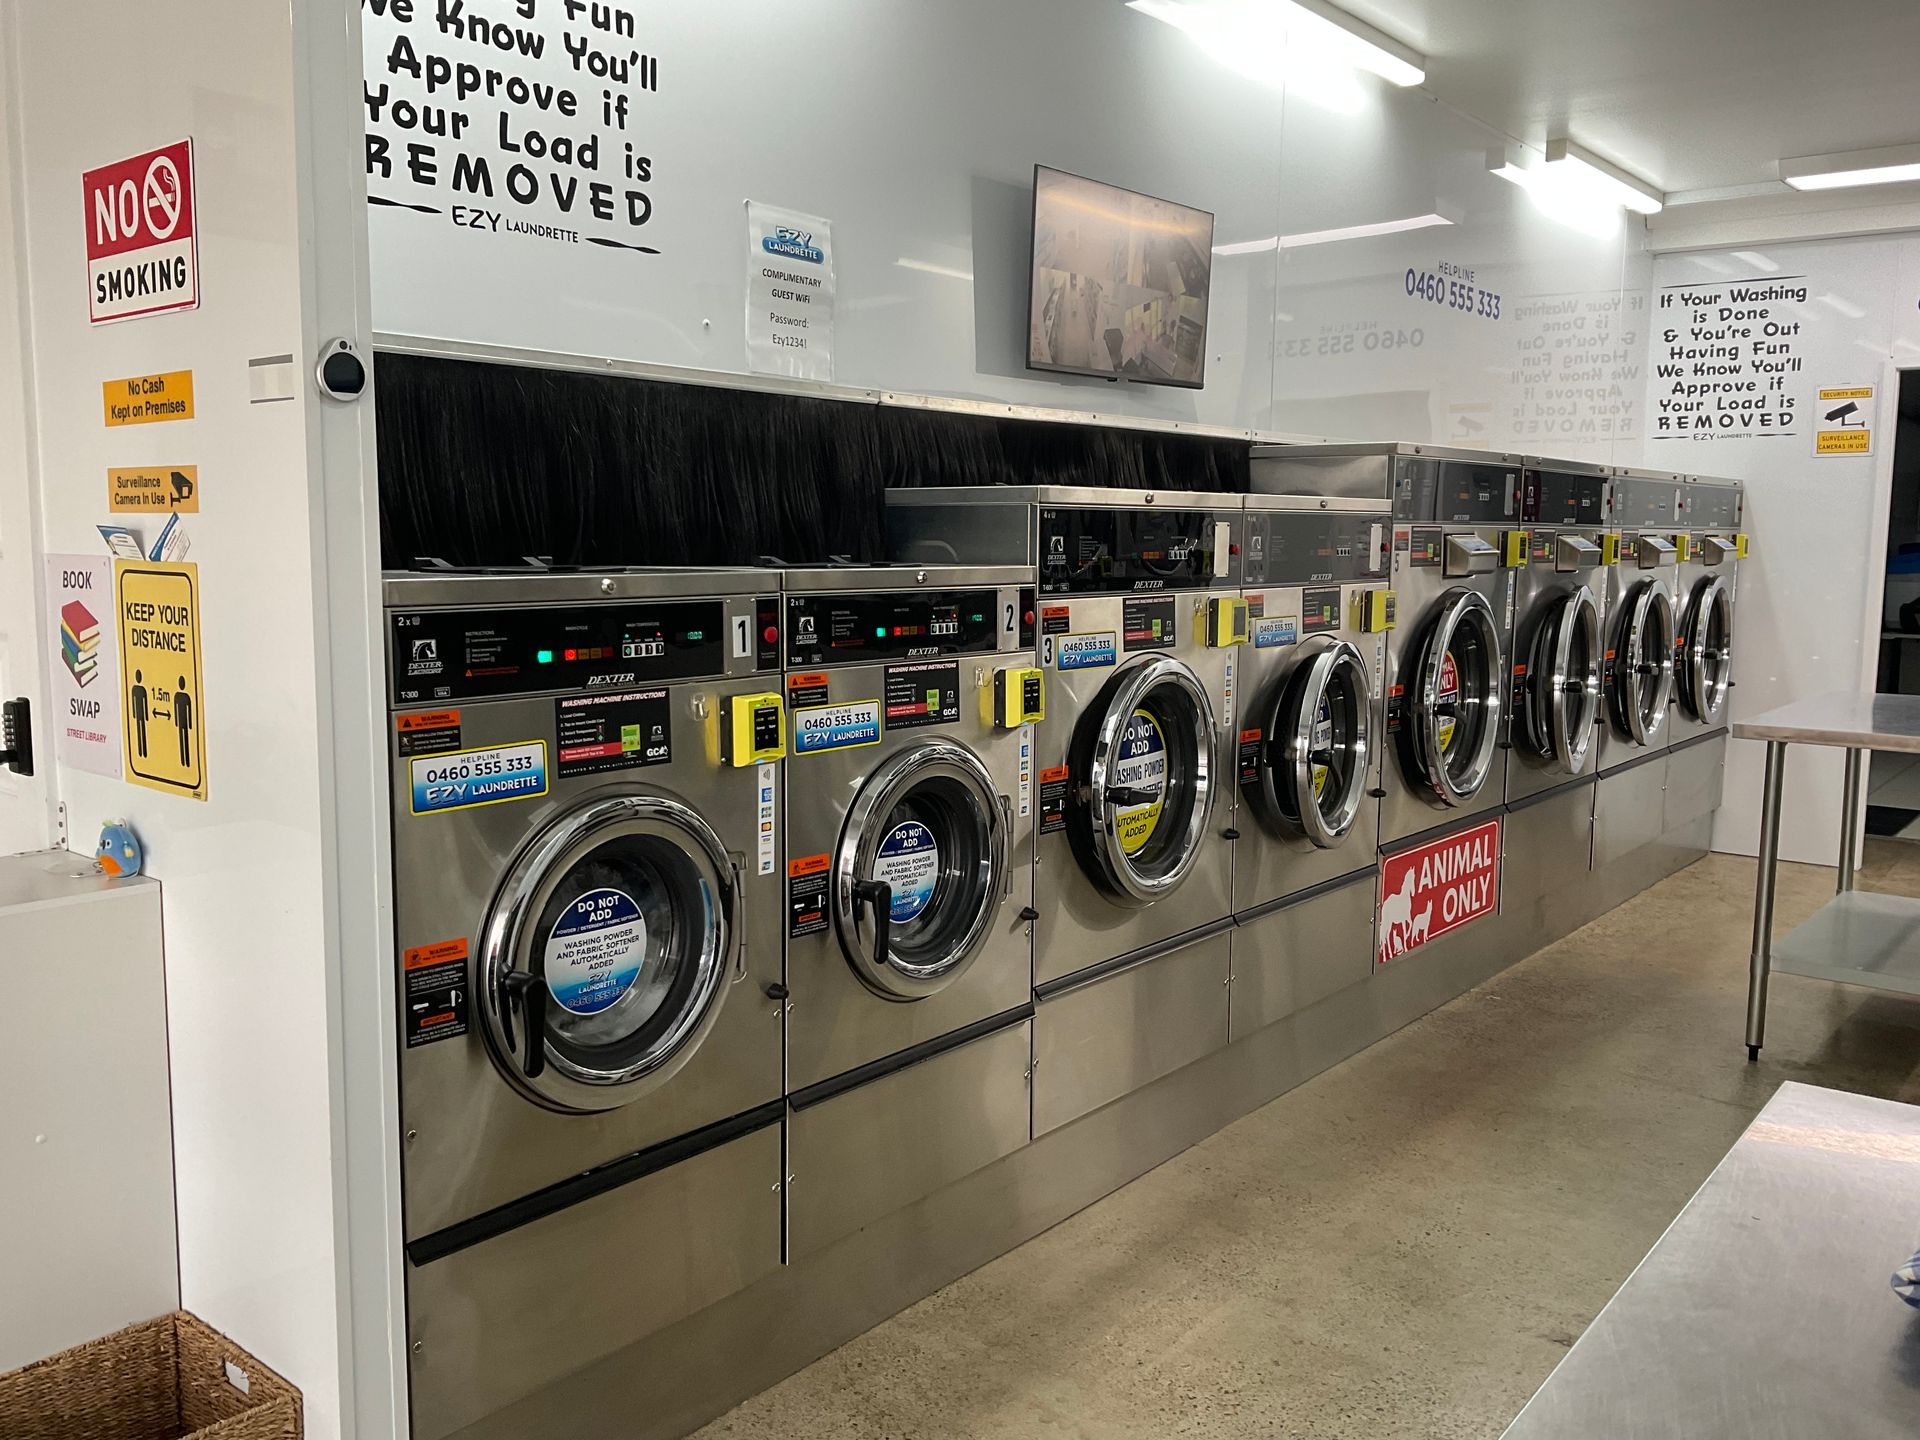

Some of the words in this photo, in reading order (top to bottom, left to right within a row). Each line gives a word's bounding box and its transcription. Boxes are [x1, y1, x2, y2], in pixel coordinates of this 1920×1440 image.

[436, 0, 544, 59] Know
[564, 32, 657, 92] You'll
[388, 36, 577, 116] Approve
[603, 90, 628, 129] if
[364, 80, 469, 139] Your
[500, 112, 598, 170] Load
[625, 143, 651, 182] is
[366, 134, 651, 226] REMOVED
[95, 180, 138, 244] NO
[452, 205, 501, 232] EZY
[506, 219, 578, 243] LAUNDRETTE
[776, 226, 812, 248] EZY
[769, 241, 817, 259] LAUNDRETTE
[97, 256, 186, 303] SMOKING
[762, 268, 821, 288] COMPLIMENTARY
[1438, 261, 1475, 283] HELPLINE
[772, 289, 793, 301] GUEST
[796, 294, 810, 304] WiFi
[1405, 268, 1445, 304] 0460
[1450, 281, 1473, 312] 555
[1477, 290, 1500, 320] 333
[1660, 294, 1673, 308] If
[1681, 293, 1721, 306] Your
[1730, 285, 1807, 303] Washing
[770, 312, 809, 328] Password:
[1693, 310, 1707, 323] is
[1719, 308, 1769, 321] Done
[772, 334, 807, 348] Ezy1234!
[1663, 329, 1678, 342] &
[1691, 325, 1751, 341] You're
[1764, 322, 1800, 336] Out
[1670, 344, 1739, 360] Having
[1753, 341, 1790, 355] Fun
[1657, 365, 1684, 378] We
[1693, 362, 1742, 376] Know
[1752, 358, 1801, 373] You'll
[128, 381, 140, 396] No
[142, 378, 164, 393] Cash
[1672, 381, 1756, 398] Approve
[1769, 376, 1784, 390] if
[111, 405, 130, 423] Kept
[133, 405, 143, 417] on
[145, 399, 185, 416] Premises
[1659, 399, 1704, 412] Your
[1717, 395, 1766, 410] Load
[1780, 394, 1795, 408] is
[1658, 412, 1793, 430] REMOVED
[117, 476, 161, 488] Surveillance
[114, 492, 141, 505] Camera
[142, 492, 149, 505] In
[151, 492, 165, 505] Use
[62, 570, 92, 589] BOOK
[1134, 581, 1163, 589] DEXTER
[126, 602, 154, 621] KEEP
[158, 605, 189, 626] YOUR
[398, 617, 404, 626] 2
[1006, 604, 1014, 632] 2
[132, 629, 186, 652] DISTANCE
[738, 620, 746, 653] 1
[908, 647, 938, 656] DEXTER
[1044, 638, 1052, 664] 3
[1064, 643, 1082, 652] 0460
[1084, 641, 1097, 650] 555
[1099, 640, 1110, 649] 333
[408, 661, 442, 669] DEXTER
[1063, 654, 1082, 664] EZY
[1083, 653, 1113, 663] LAUNDRETTE
[889, 666, 909, 674] WASHING
[928, 663, 956, 671] INSTRUCTIONS
[587, 673, 635, 685] DEXTER
[151, 687, 170, 703] 1.5m
[562, 698, 592, 707] WASHING
[593, 695, 622, 703] MACHINE
[622, 691, 666, 701] INSTRUCTIONS
[70, 698, 100, 719] SWAP
[826, 708, 851, 716] HELPLINE
[805, 718, 832, 730] 0460
[835, 715, 852, 726] 555
[854, 712, 871, 723] 333
[67, 728, 85, 740] STREET
[85, 731, 107, 743] LIBRARY
[804, 732, 830, 746] EZY
[833, 728, 874, 741] LAUNDRETTE
[1138, 723, 1154, 738] NOT
[1131, 740, 1149, 755] ADD
[461, 753, 500, 764] HELPLINE
[427, 765, 469, 783] 0460
[475, 761, 501, 776] 555
[507, 756, 532, 772] 333
[1117, 764, 1142, 785] ASHING
[1145, 758, 1164, 779] POWDER
[426, 783, 468, 805] EZY
[472, 776, 538, 796] LAUNDRETTE
[1117, 807, 1158, 828] UTOMATICALLY
[896, 831, 907, 839] DO
[909, 828, 923, 837] NOT
[1124, 824, 1146, 839] ADDED
[903, 839, 918, 848] ADD
[887, 859, 911, 868] WASHING
[911, 856, 931, 864] POWDER
[894, 866, 912, 875] FABRIC
[913, 862, 935, 872] SOFTENER
[1418, 834, 1492, 893] ANIMAL
[890, 870, 928, 882] AUTOMATICALLY
[902, 879, 918, 887] ADDED
[578, 900, 595, 913] DO
[598, 895, 620, 908] NOT
[1443, 872, 1490, 922] ONLY
[589, 909, 612, 923] ADD
[556, 951, 574, 960] AND
[576, 946, 603, 957] FABRIC
[606, 935, 640, 950] SOFTENER
[565, 937, 601, 950] WASHING
[604, 928, 633, 941] POWDER
[571, 946, 629, 966] AUTOMATICALLY
[589, 959, 614, 971] ADDED
[579, 978, 616, 994] LAUNDRETTE
